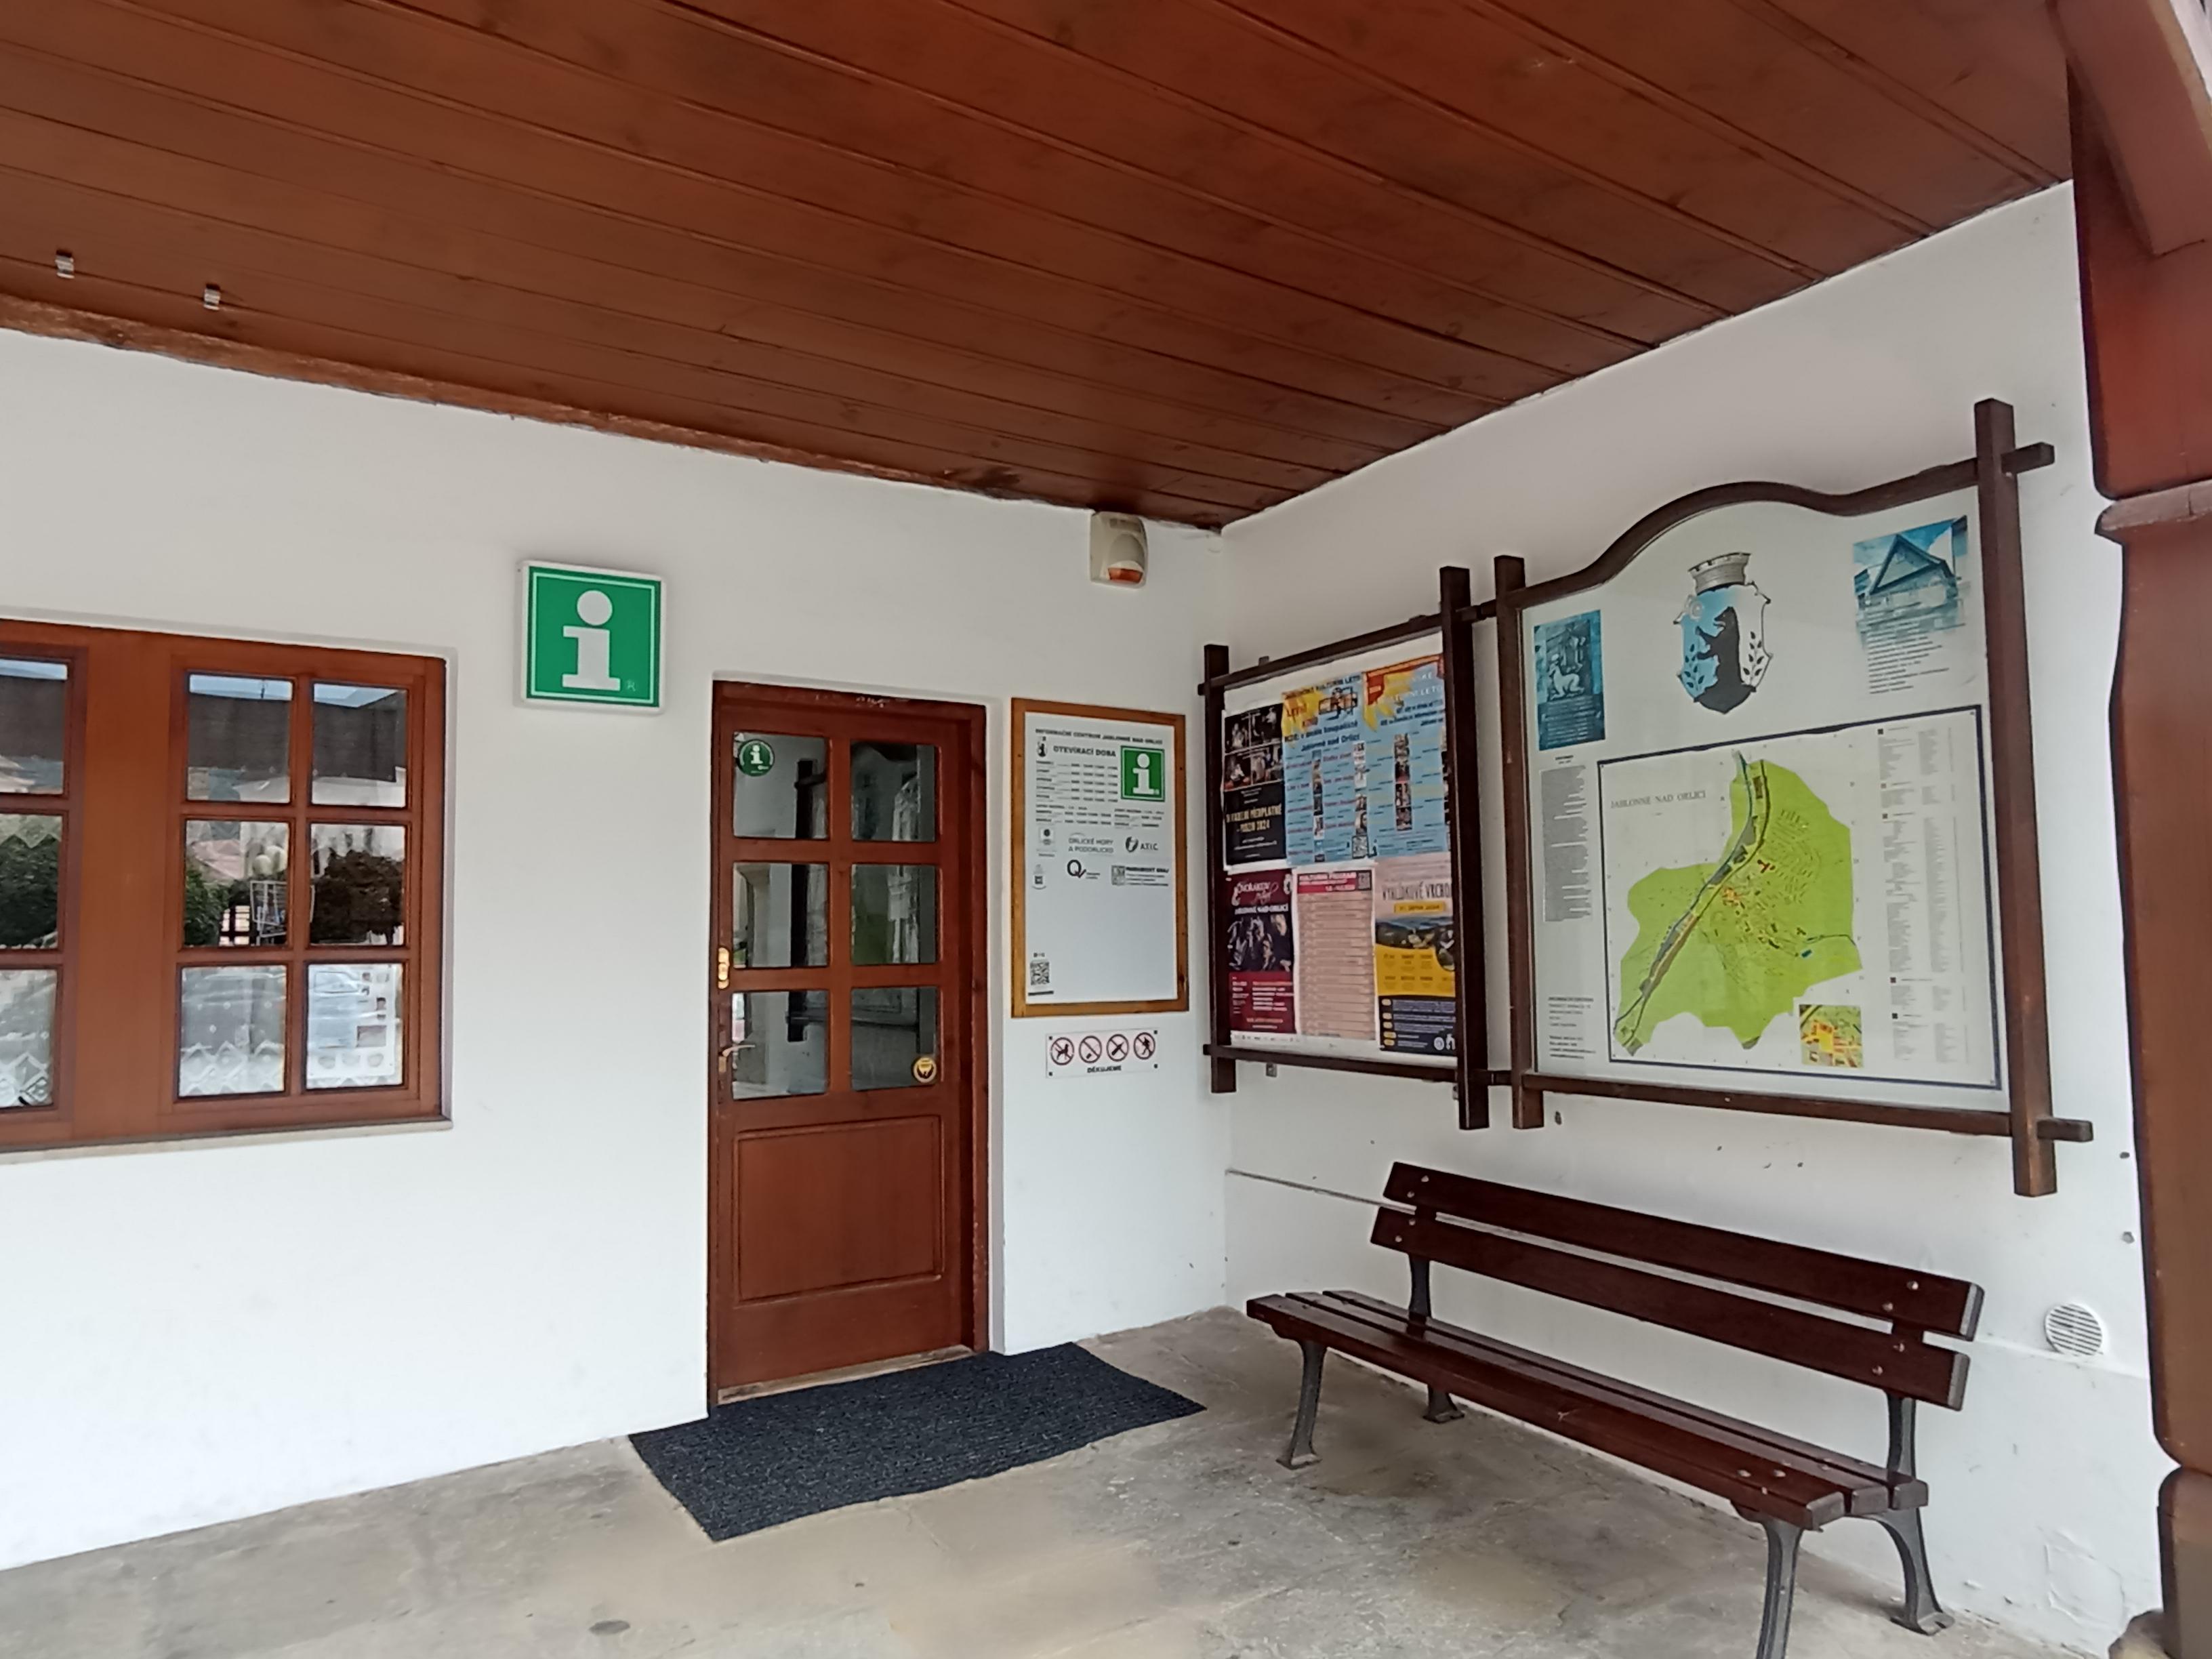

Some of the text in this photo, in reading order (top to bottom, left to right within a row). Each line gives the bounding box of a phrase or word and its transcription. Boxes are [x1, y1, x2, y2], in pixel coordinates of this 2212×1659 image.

[1053, 745, 1117, 758] OTEVÍRACÍ DOBA
[1654, 794, 1674, 803] NAD
[1068, 837, 1094, 845] ORLICKÉ
[1087, 1065, 1122, 1073] DĚKUJEME
